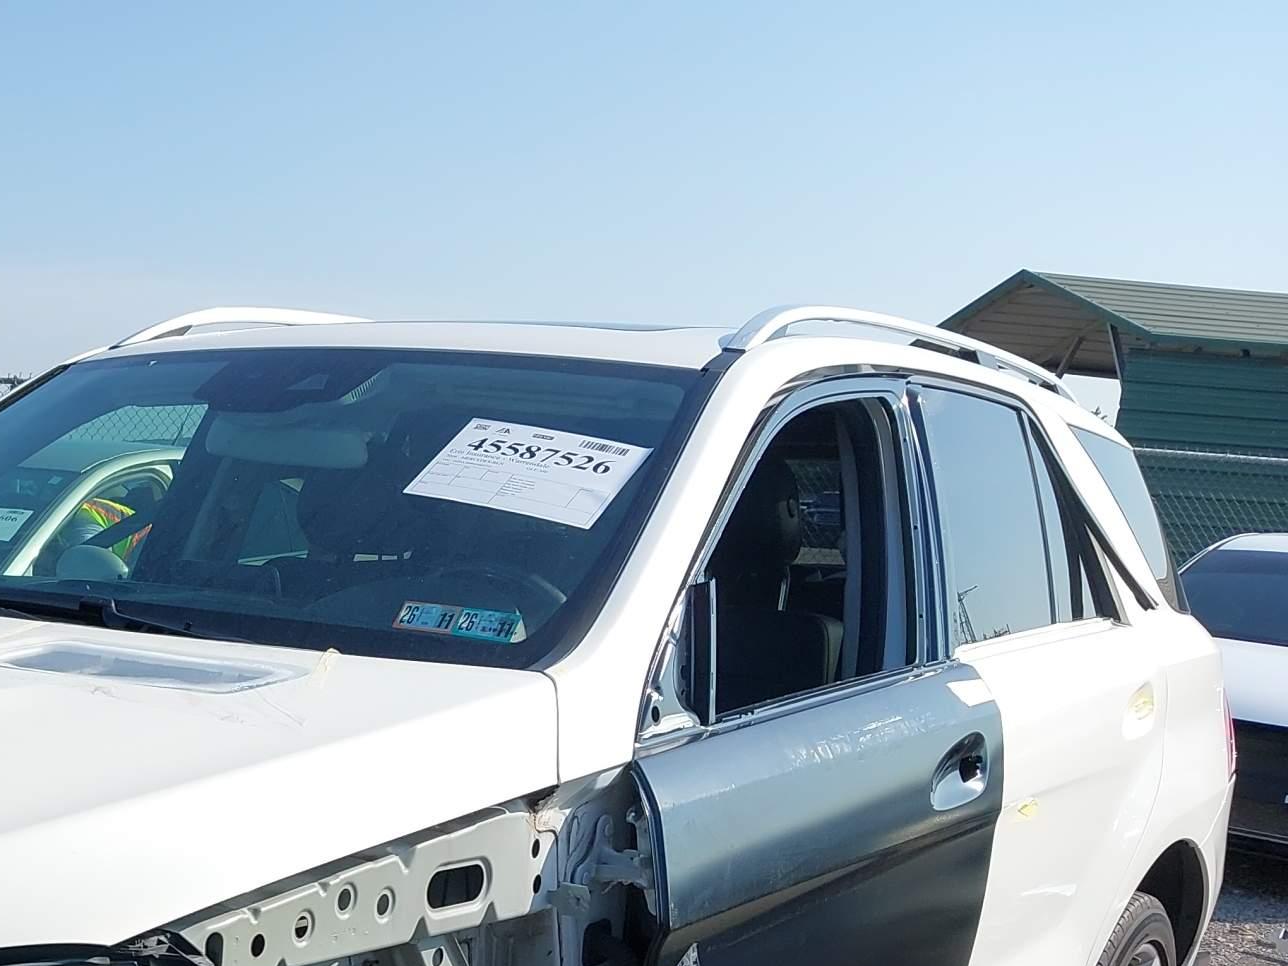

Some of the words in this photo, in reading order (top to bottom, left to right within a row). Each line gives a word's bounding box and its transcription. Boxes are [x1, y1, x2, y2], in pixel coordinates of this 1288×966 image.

[466, 437, 617, 475] 45587526
[399, 604, 420, 625] 26
[457, 611, 478, 632] 26
